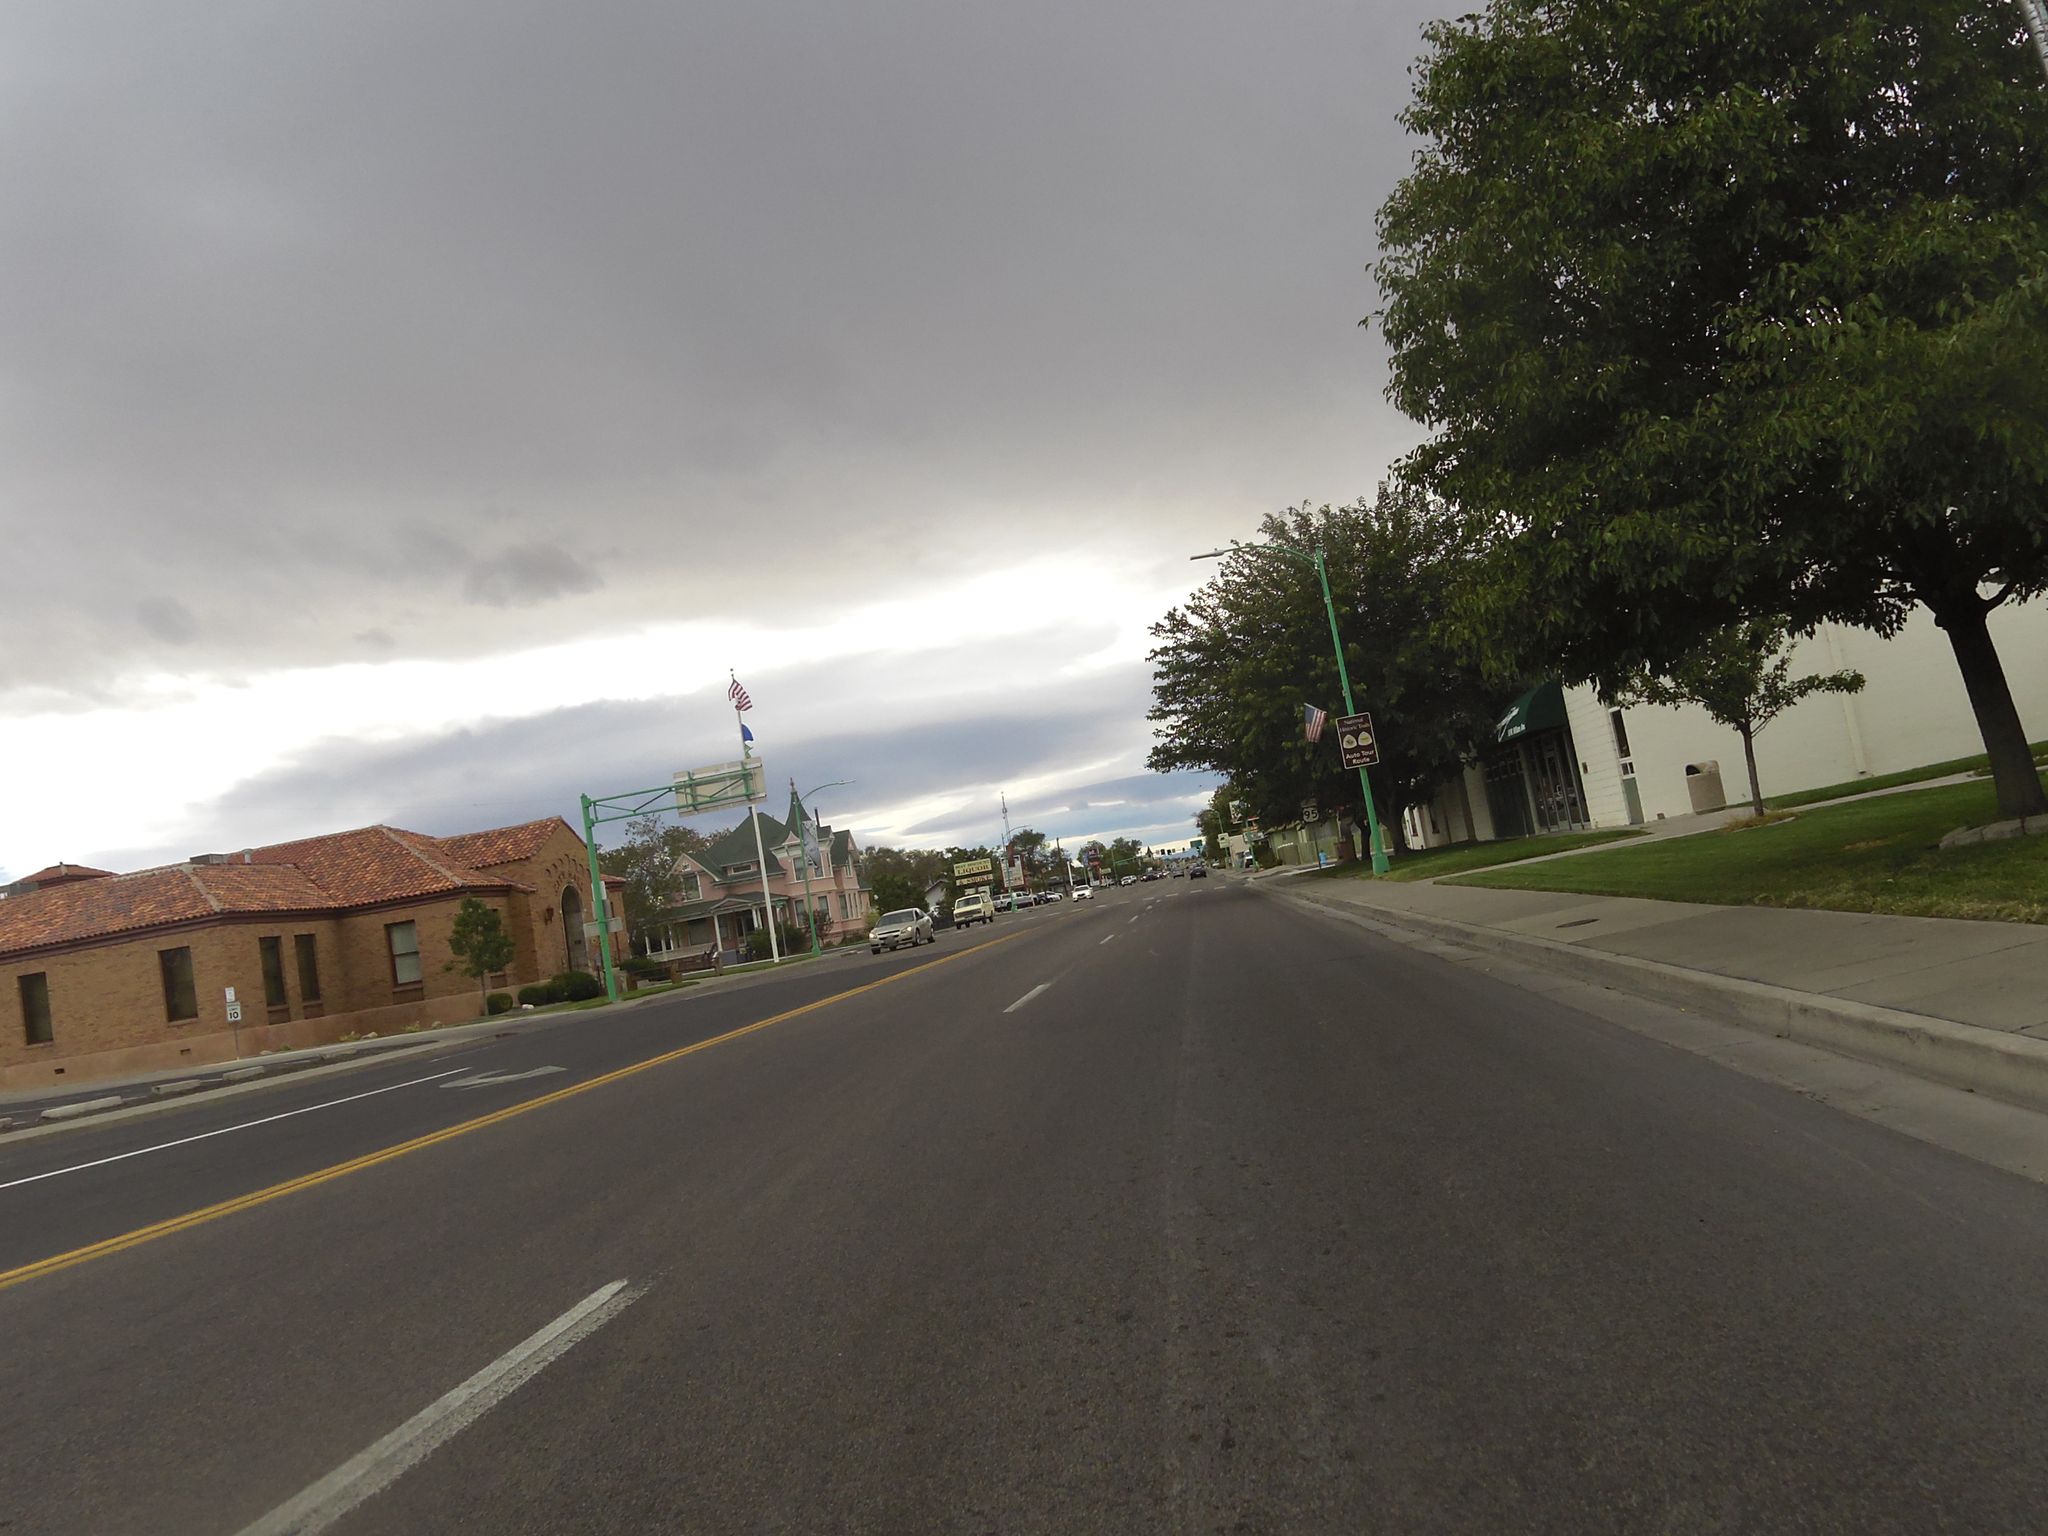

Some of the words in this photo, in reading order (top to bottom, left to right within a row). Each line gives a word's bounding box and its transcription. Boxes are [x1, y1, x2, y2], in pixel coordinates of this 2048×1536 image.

[1304, 809, 1318, 819] 95
[957, 864, 989, 875] LIQUOR
[229, 1011, 239, 1019] 10
